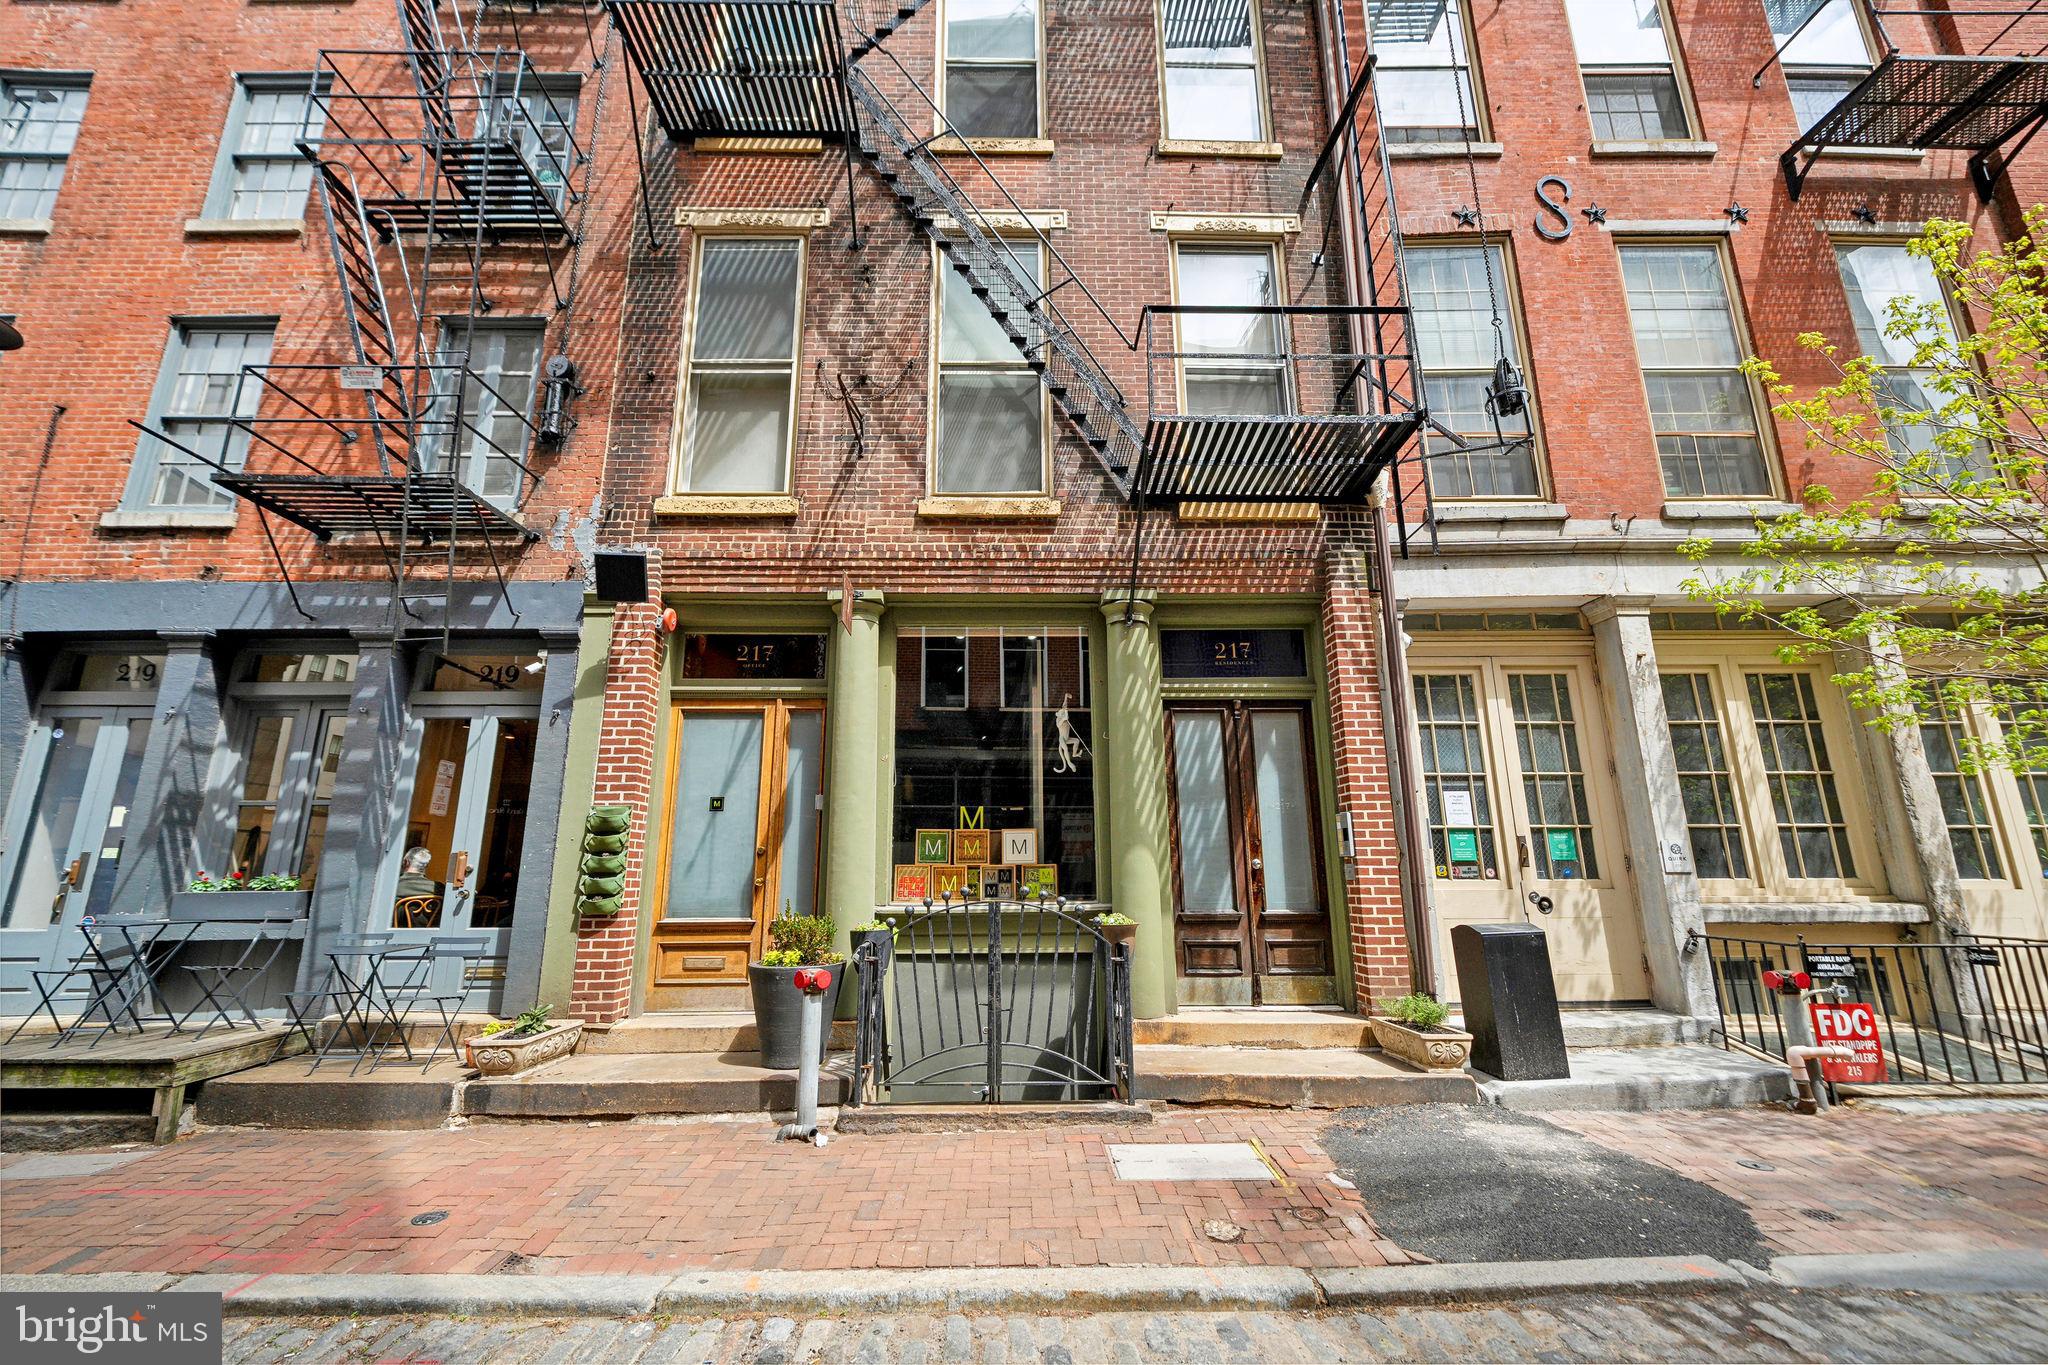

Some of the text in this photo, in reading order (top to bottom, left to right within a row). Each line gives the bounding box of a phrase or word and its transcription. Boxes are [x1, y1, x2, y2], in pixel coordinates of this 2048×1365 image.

[736, 645, 774, 661] 217
[1214, 641, 1250, 659] 217
[115, 663, 157, 682] 219
[480, 665, 520, 682] 219
[959, 805, 984, 830] M
[925, 839, 942, 856] M
[964, 839, 980, 856] M
[1011, 839, 1027, 855] M
[941, 875, 957, 892] M
[987, 871, 1010, 881] M M
[987, 886, 996, 896] M
[1807, 955, 1835, 963] PORTABLE
[1815, 1008, 1873, 1037] FDC
[1847, 1065, 1863, 1077] 215
